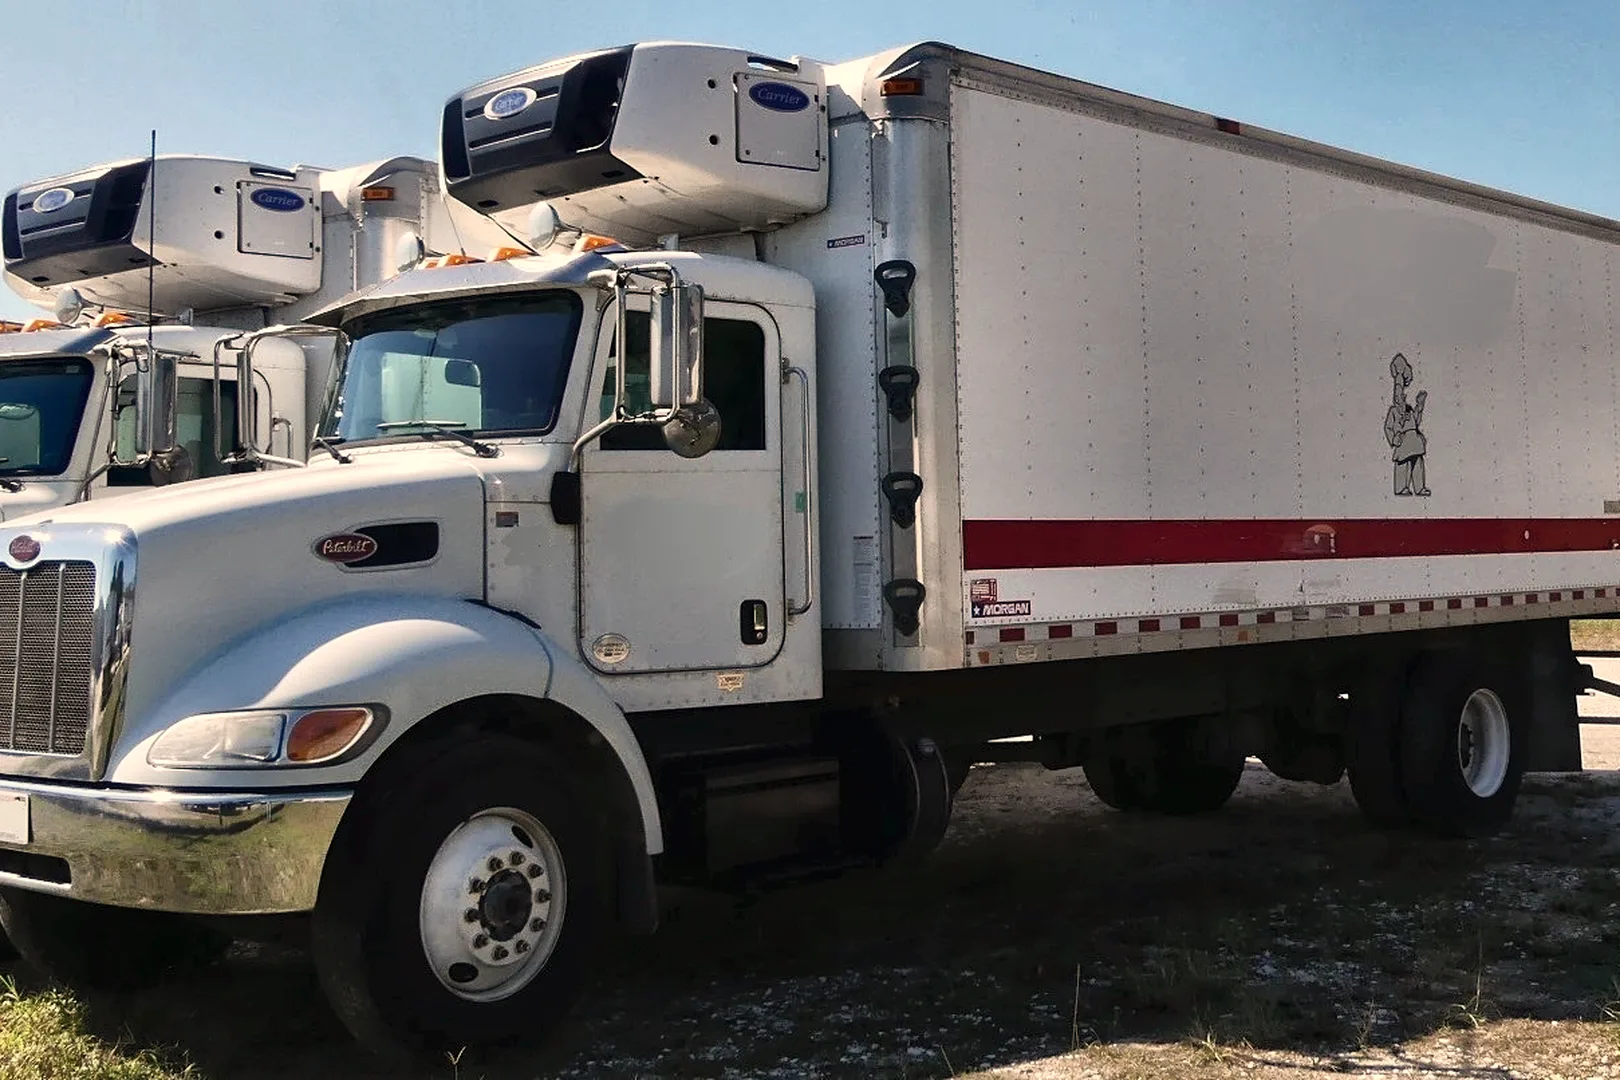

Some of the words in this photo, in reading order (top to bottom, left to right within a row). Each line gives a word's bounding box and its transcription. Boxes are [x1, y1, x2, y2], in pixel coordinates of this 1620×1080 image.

[757, 87, 802, 104] Carrier
[258, 192, 298, 206] Carrier
[323, 539, 371, 554] Peterbilt
[982, 602, 1029, 616] MORGAN
